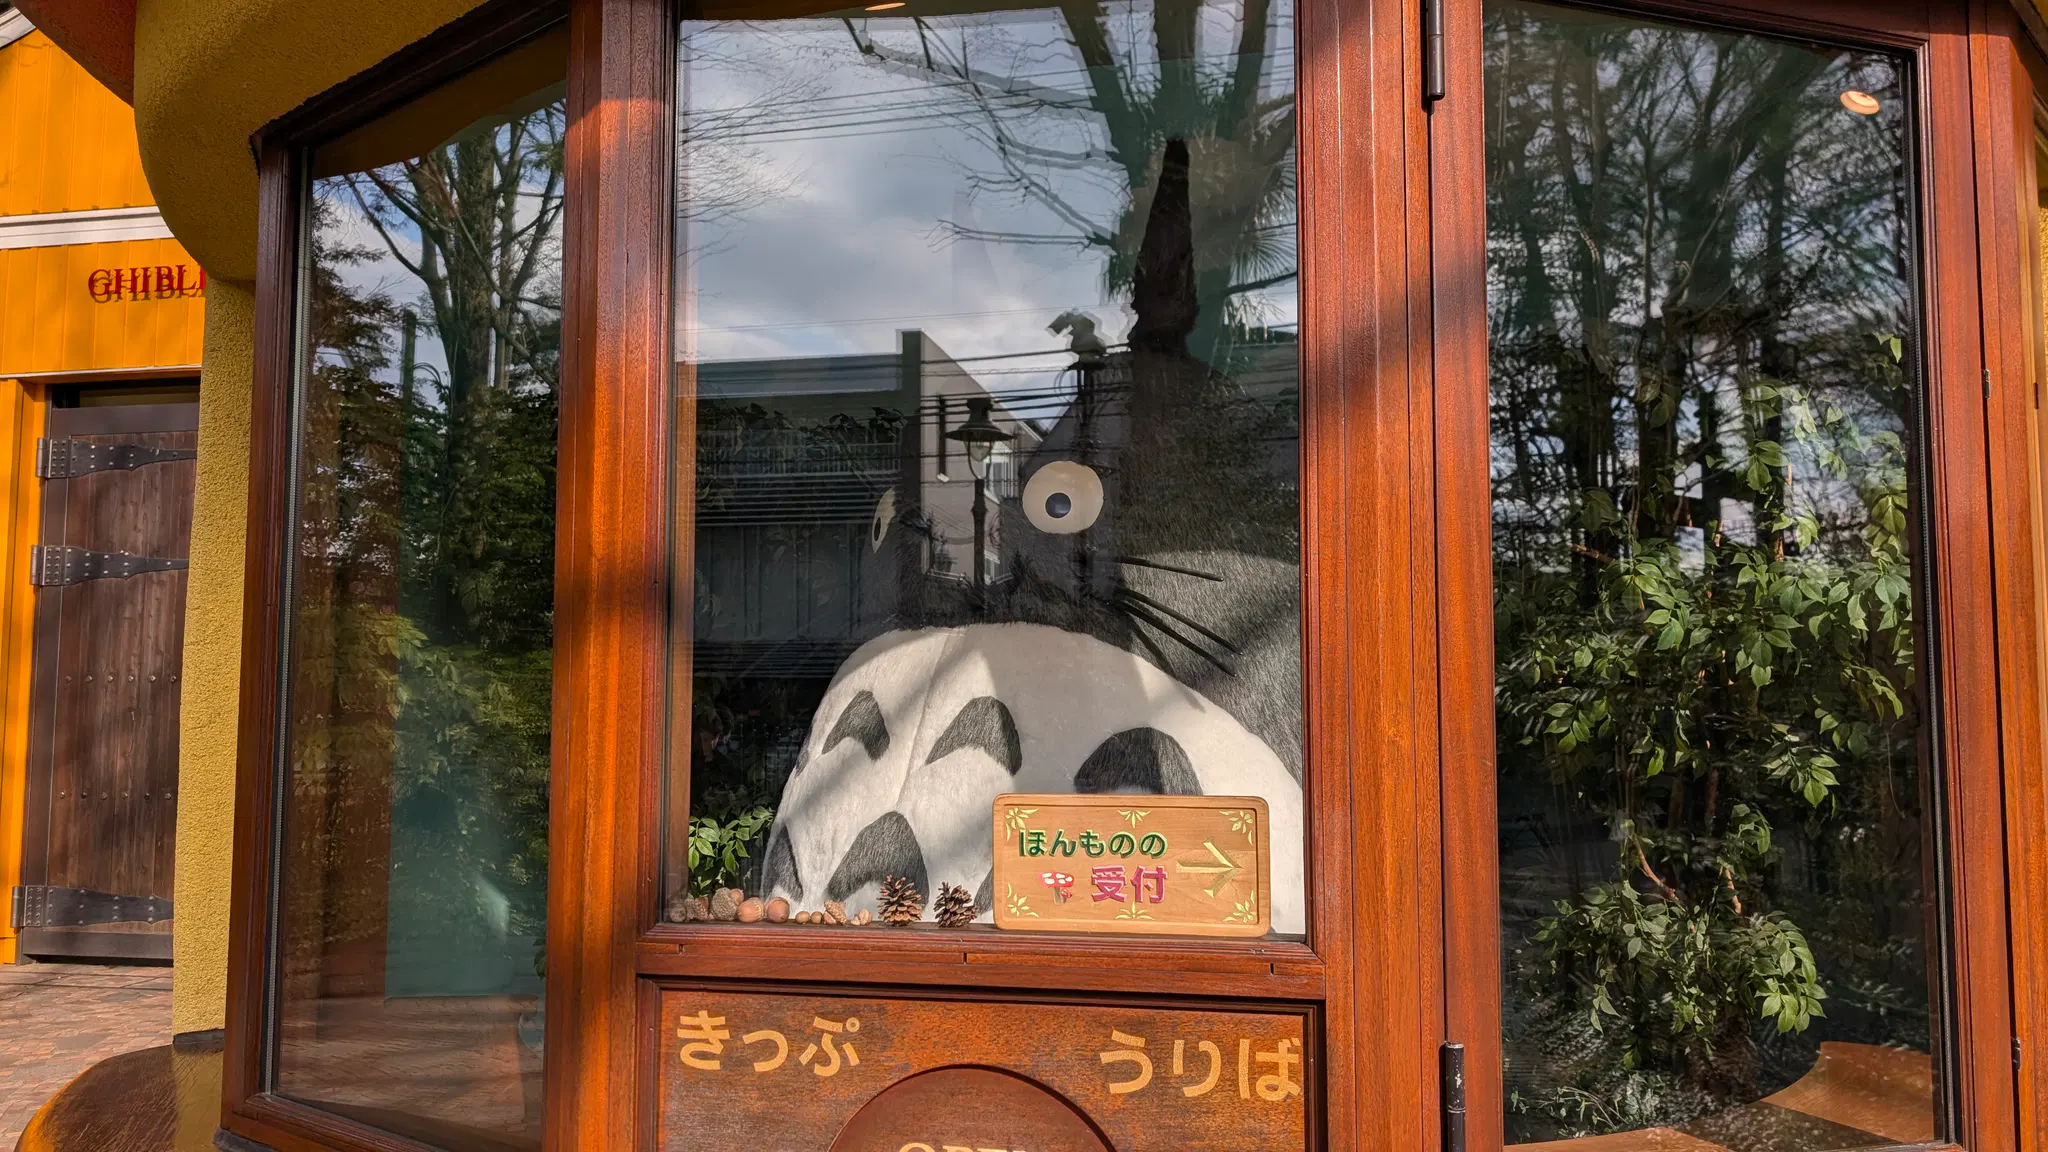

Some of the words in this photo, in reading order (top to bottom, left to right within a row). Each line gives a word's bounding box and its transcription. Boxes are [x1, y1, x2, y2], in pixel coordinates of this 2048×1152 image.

[1018, 828, 1168, 858] ほんものの
[1091, 864, 1168, 904] 受付
[676, 1009, 861, 1078] きっぷ
[1099, 1029, 1302, 1102] うりば
